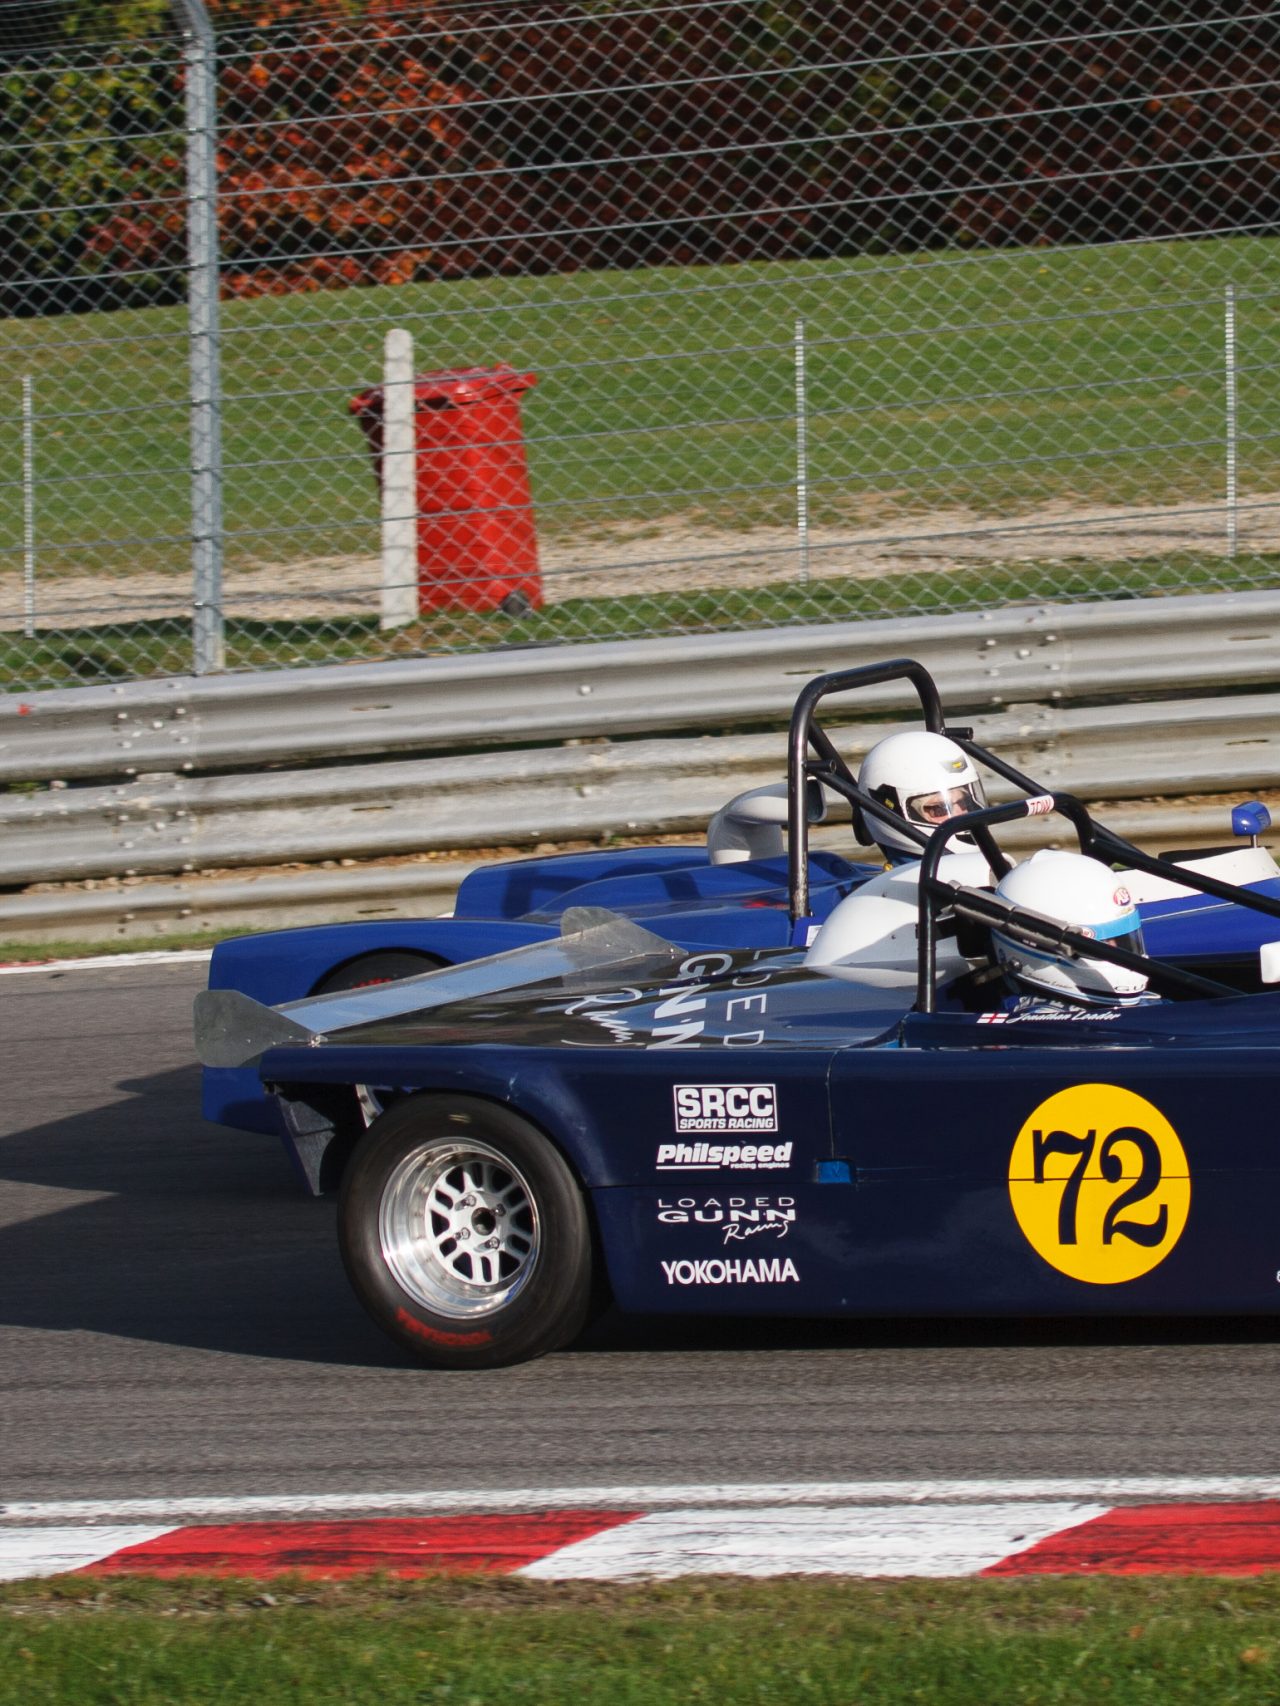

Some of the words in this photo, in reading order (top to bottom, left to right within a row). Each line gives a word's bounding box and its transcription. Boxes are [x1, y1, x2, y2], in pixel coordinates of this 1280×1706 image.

[677, 1087, 774, 1118] SRCC
[679, 1118, 727, 1129] SPORTS
[728, 1118, 775, 1129] RACING
[656, 1142, 793, 1166] Philspeed
[730, 1162, 757, 1170] racing
[1032, 1126, 1169, 1248] 72
[657, 1197, 795, 1208] LOADED
[657, 1209, 797, 1223] GUNN
[722, 1220, 789, 1245] Racing
[661, 1258, 800, 1285] YOKOHAMA
